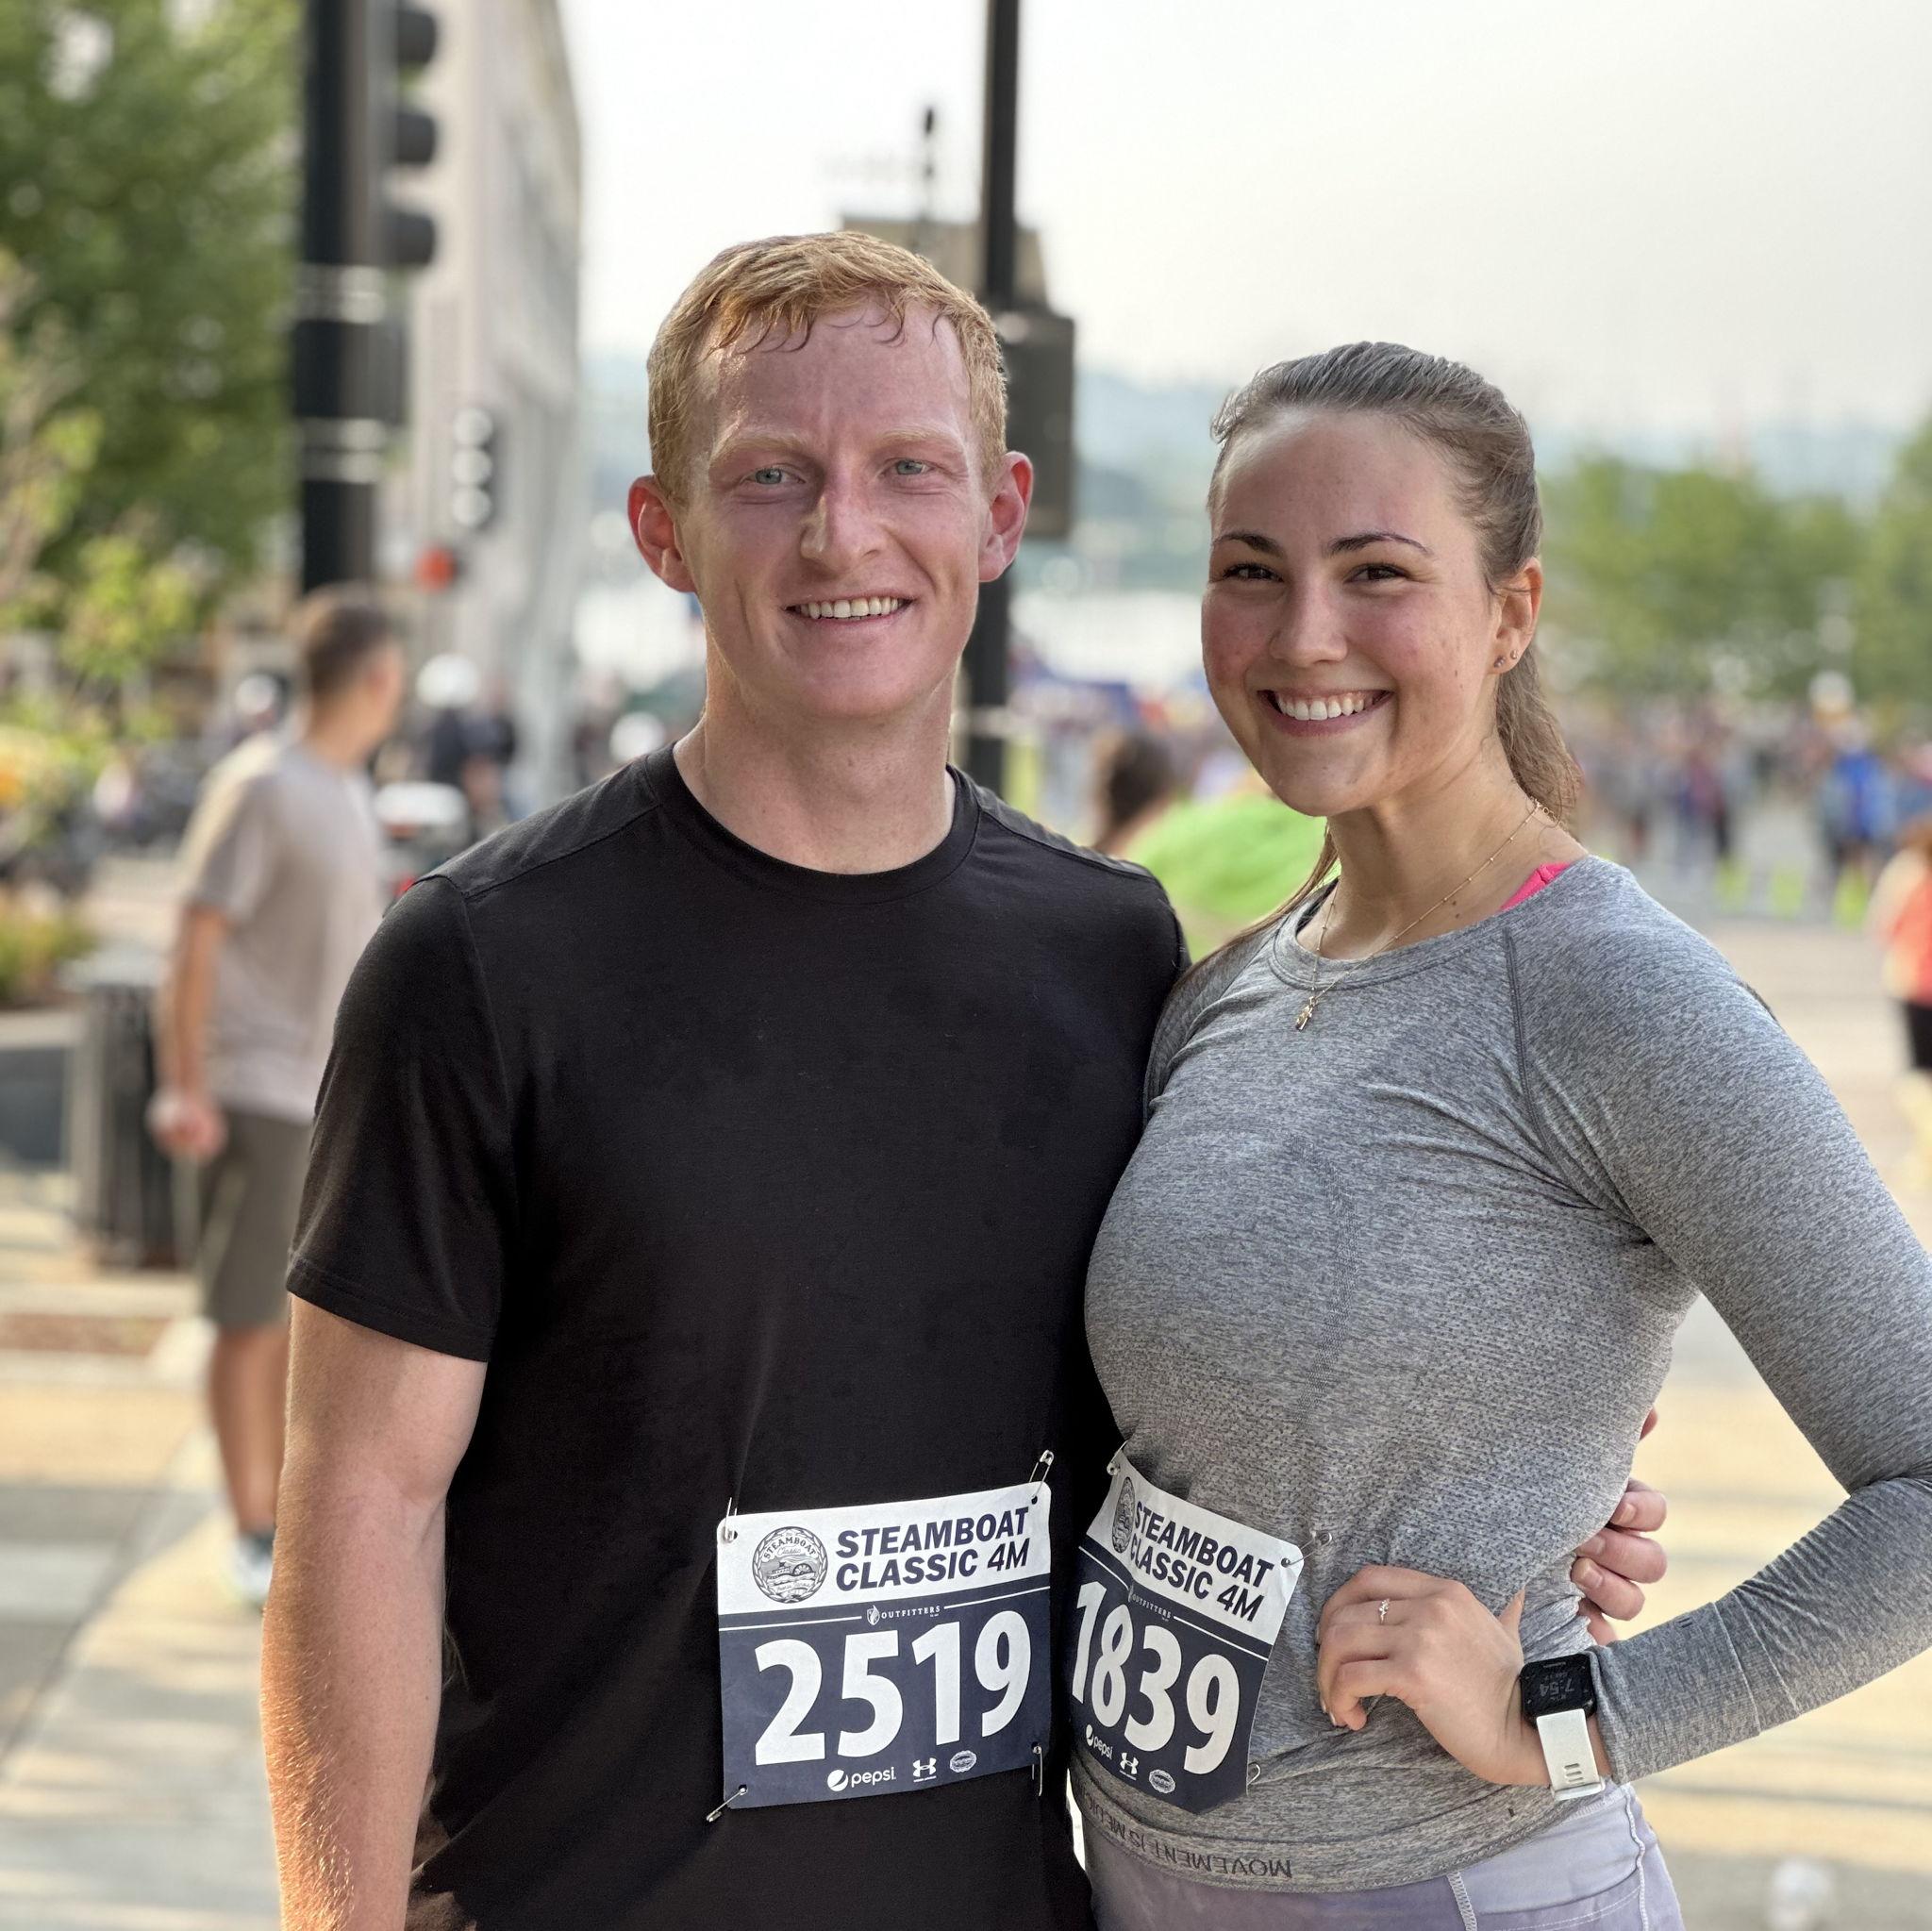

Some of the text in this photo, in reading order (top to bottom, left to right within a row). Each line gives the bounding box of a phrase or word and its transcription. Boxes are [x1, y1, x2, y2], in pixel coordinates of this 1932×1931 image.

[763, 1536, 817, 1559] STEAMBOAT
[836, 1507, 1029, 1558] STEAMBOAT
[1134, 1500, 1274, 1589] STEAMBOAT
[836, 1538, 1030, 1591] CLASSIC 4M
[1129, 1537, 1265, 1623] CLASSIC 4M
[880, 1605, 941, 1620] OUTFITTERS
[1131, 1593, 1173, 1619] OUTFITTERS
[754, 1610, 1032, 1767] 2519
[1072, 1580, 1241, 1775] 1839
[1540, 1676, 1575, 1697] 7:54
[1092, 1736, 1114, 1760] pepsi
[851, 1766, 895, 1788] pepsi
[1129, 1829, 1145, 1852] IS
[1155, 1839, 1292, 1878] MOVEMENT
